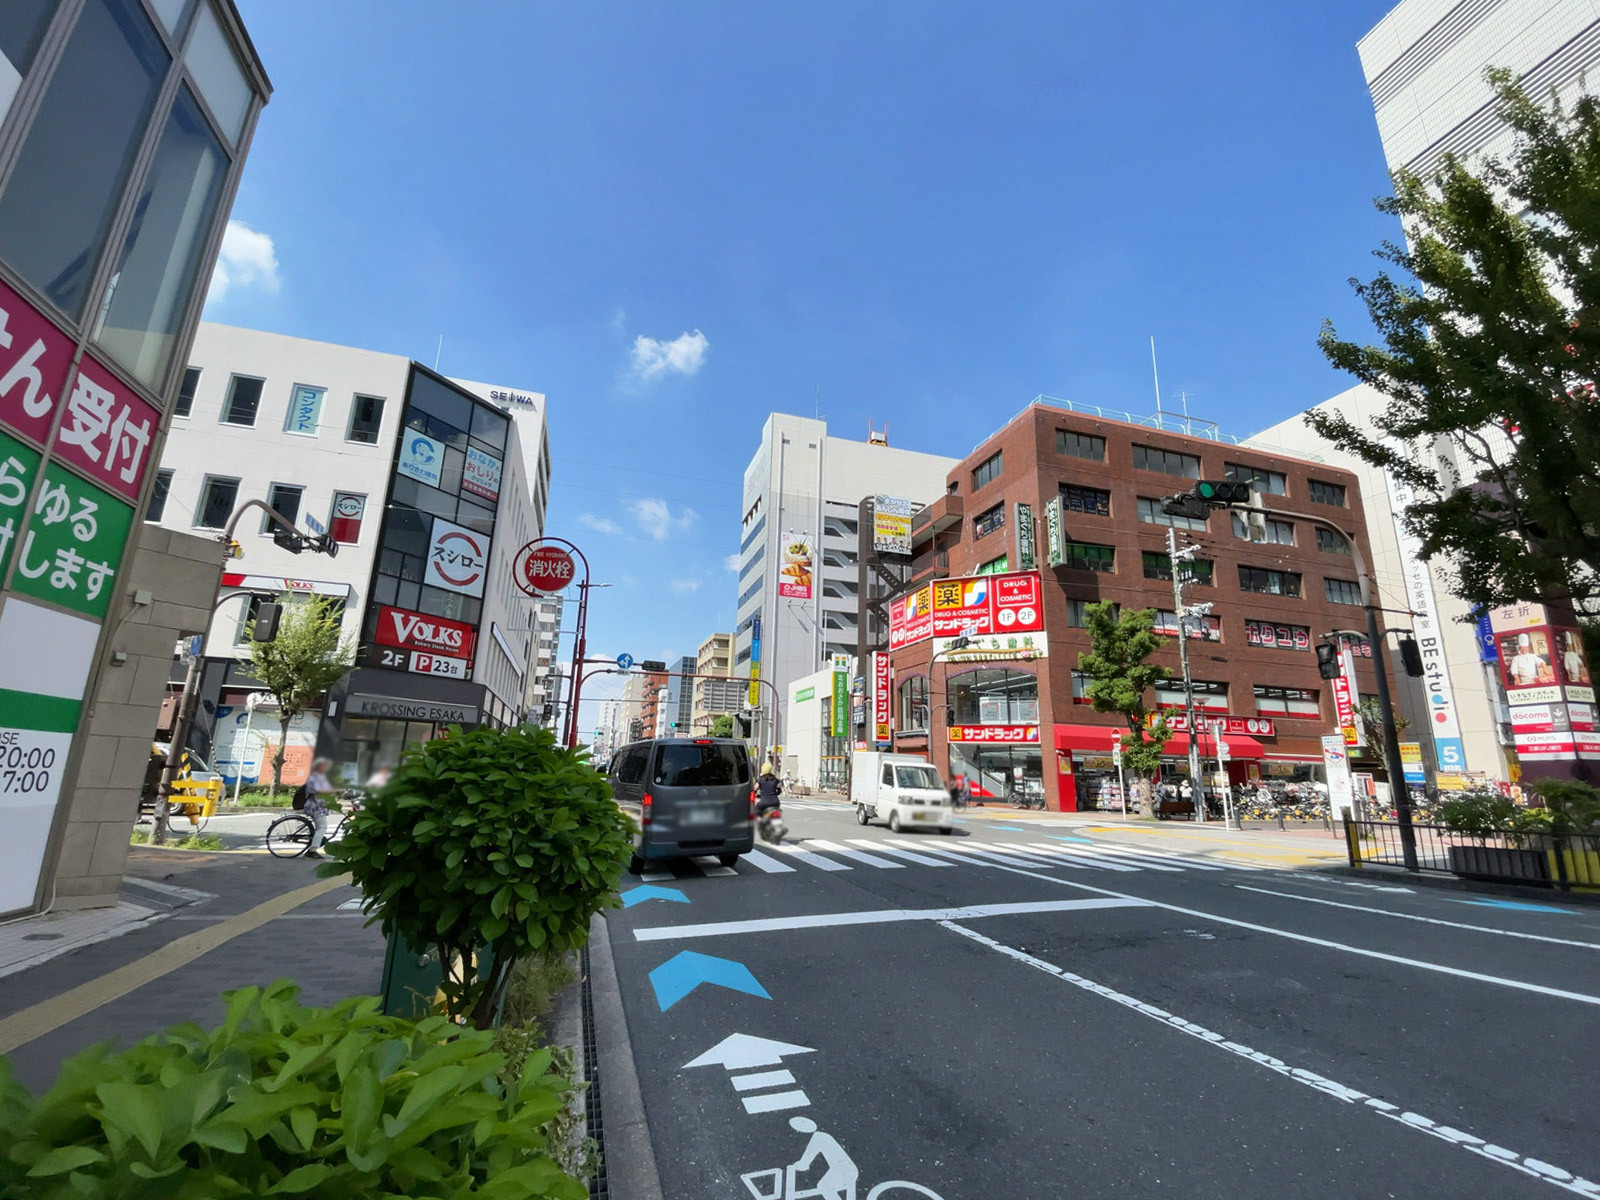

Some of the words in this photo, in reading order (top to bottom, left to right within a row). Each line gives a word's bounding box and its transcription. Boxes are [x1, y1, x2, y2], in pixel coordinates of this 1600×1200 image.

[490, 390, 534, 406] SEIWA
[336, 502, 362, 510] スシロー
[430, 546, 484, 569] スシロー
[529, 559, 571, 579] 消火栓
[918, 590, 929, 614] 薬
[937, 583, 960, 606] 薬
[1000, 594, 1032, 602] COSMETIC
[958, 608, 989, 616] COSMETIC
[1002, 613, 1013, 621] 1F
[1021, 611, 1033, 620] 2F
[390, 611, 463, 648] VOLKS
[906, 622, 931, 640] サンドラッグ
[934, 616, 989, 631] サンドラッグ
[381, 650, 404, 667] 2F
[418, 656, 430, 670] P
[434, 659, 458, 675] 23台
[877, 655, 888, 723] サンドラッグ
[361, 701, 426, 718] KROSSING
[429, 708, 465, 722] ESAKA
[1512, 711, 1549, 720] docomo
[964, 728, 1024, 740] サンドラッグ
[1442, 745, 1459, 764] 5
